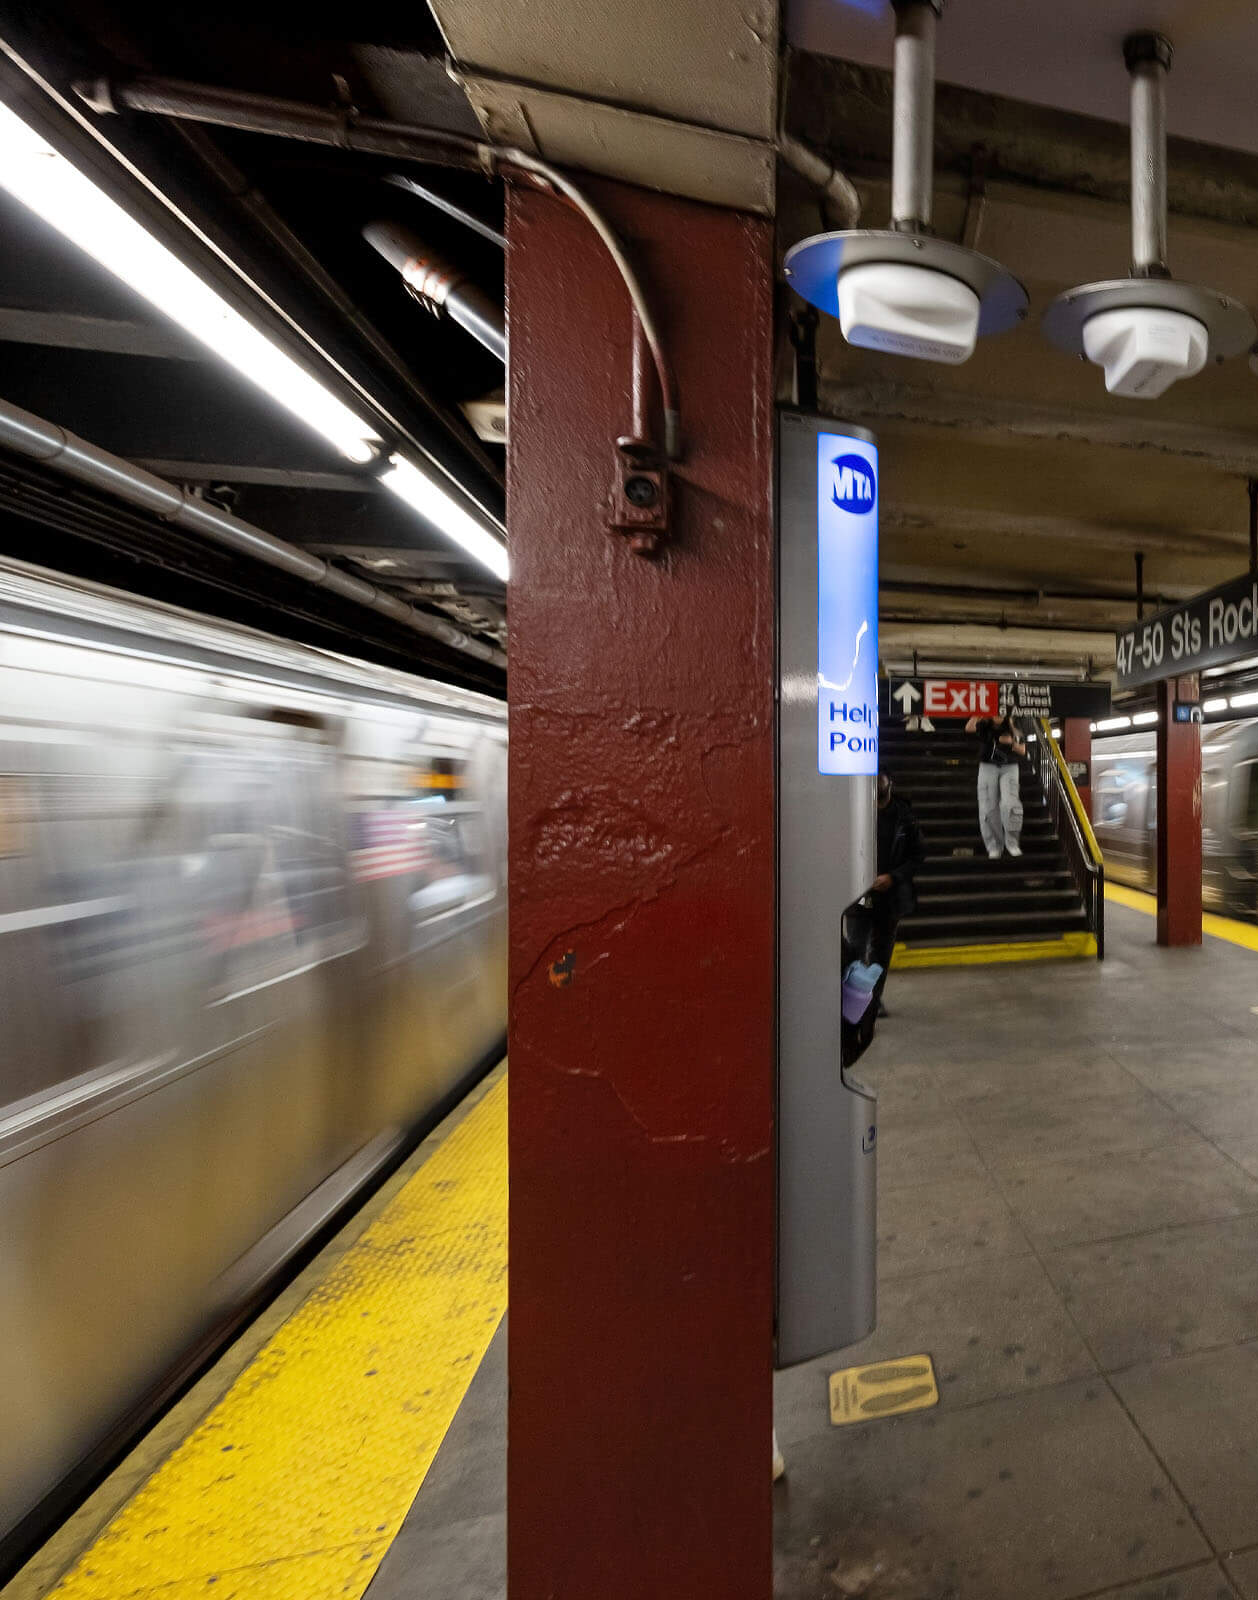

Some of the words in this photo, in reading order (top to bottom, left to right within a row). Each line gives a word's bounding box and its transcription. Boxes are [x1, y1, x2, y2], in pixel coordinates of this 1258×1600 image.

[832, 463, 872, 500] MTA
[1116, 621, 1164, 676] 47-50
[1171, 610, 1201, 661] Sts
[924, 680, 990, 713] Exit
[1011, 706, 1050, 718] Avenue
